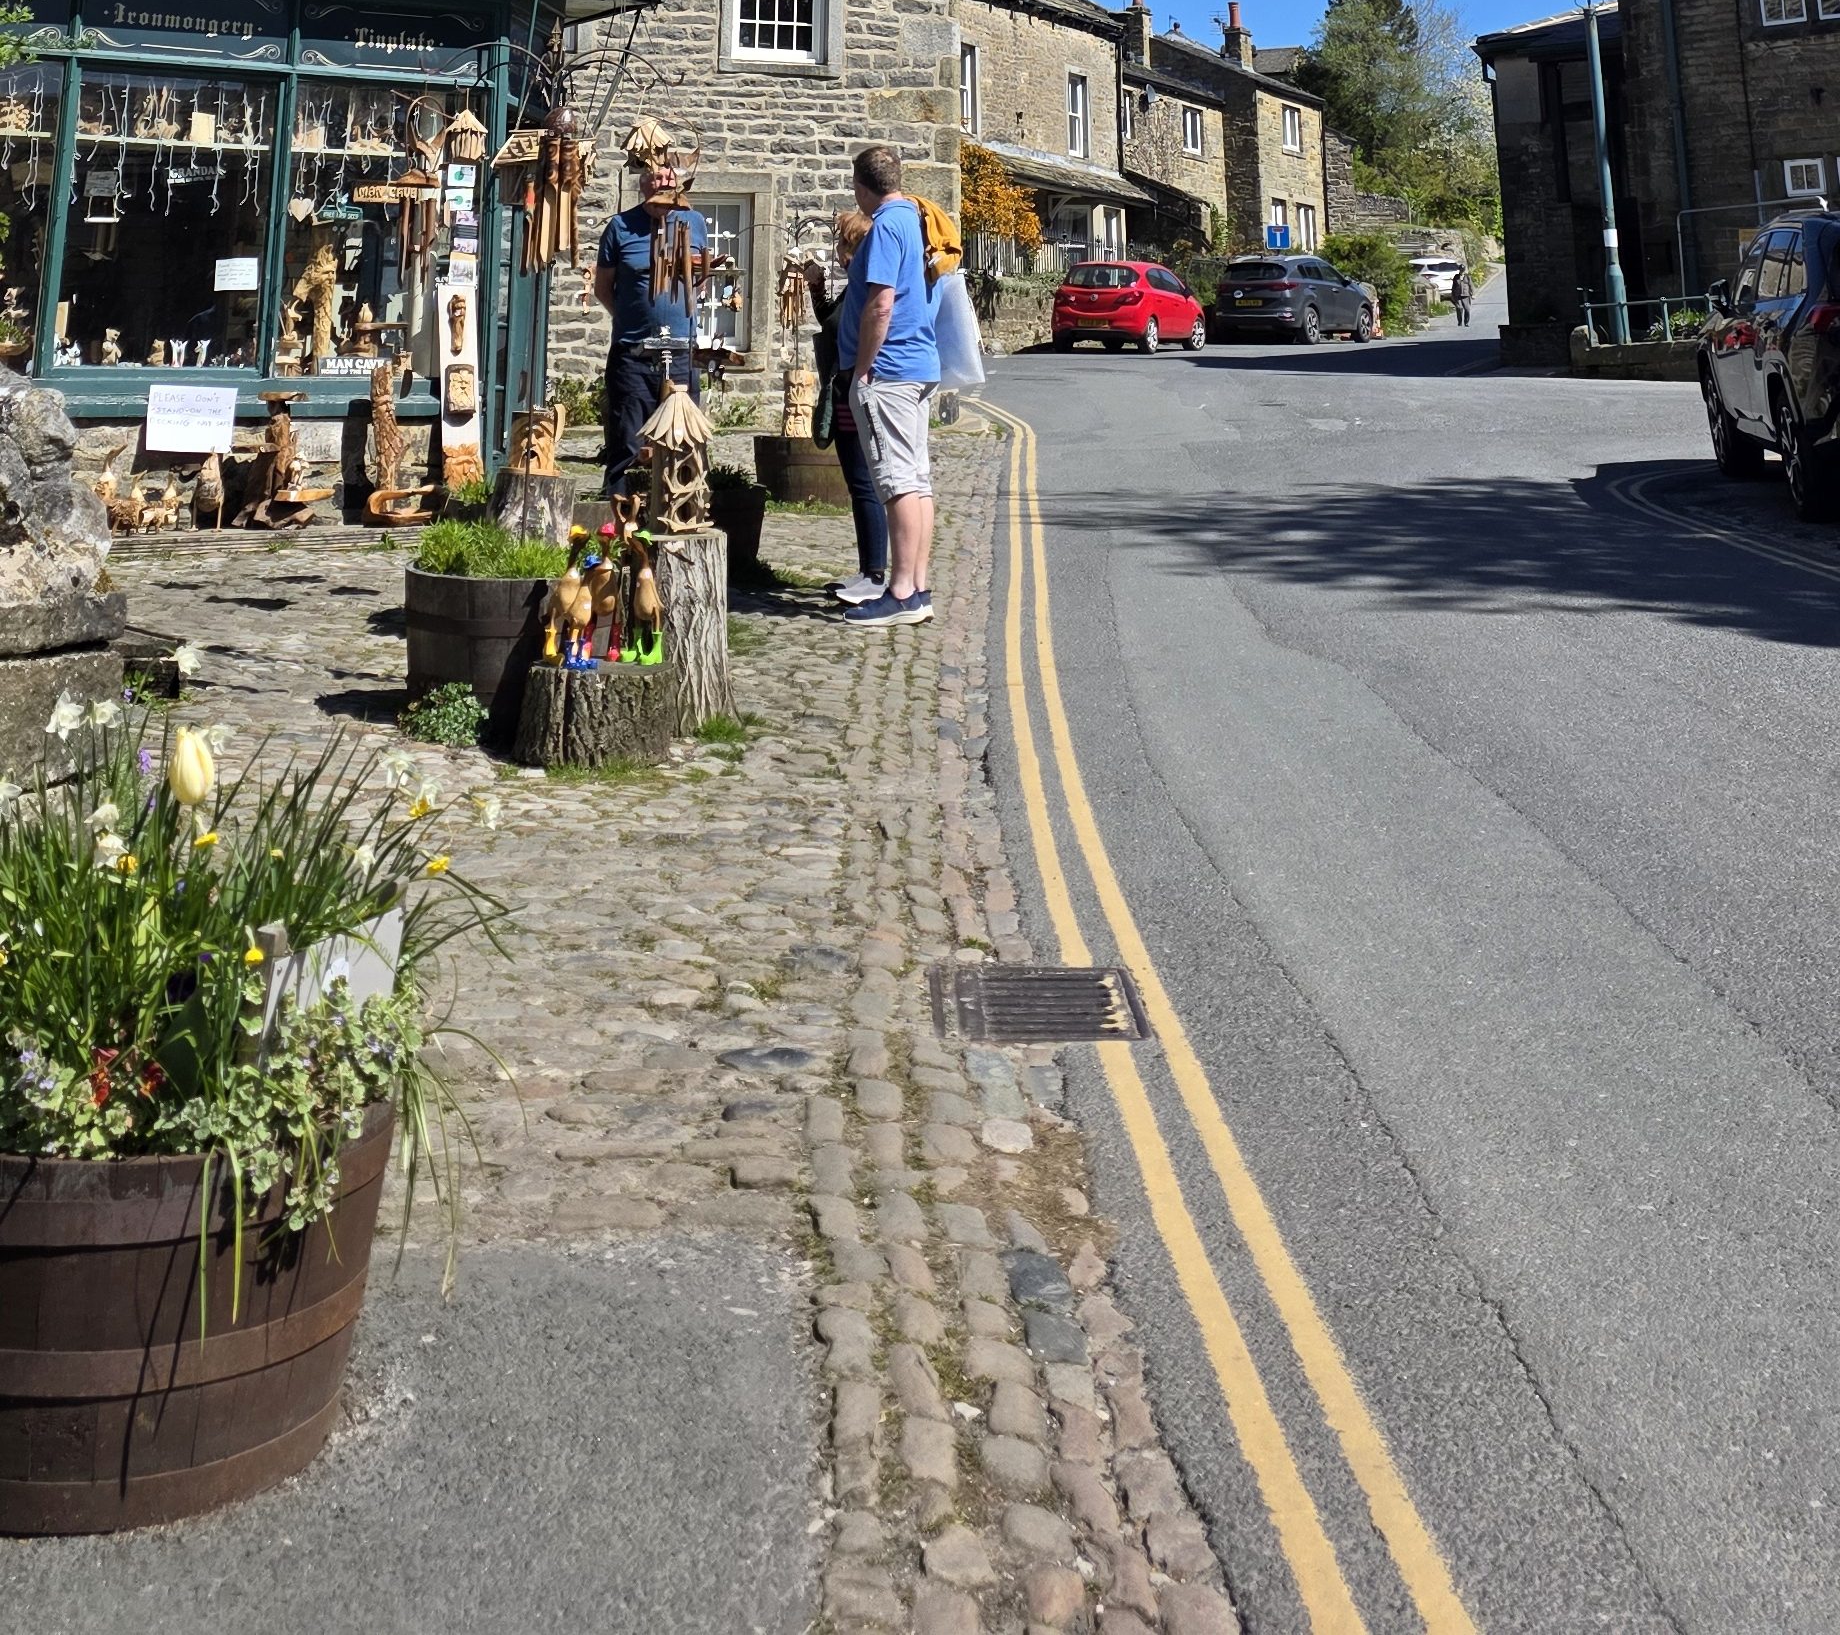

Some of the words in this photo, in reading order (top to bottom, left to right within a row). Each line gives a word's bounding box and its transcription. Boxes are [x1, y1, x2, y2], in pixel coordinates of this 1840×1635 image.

[113, 2, 254, 41] Ironmongery
[354, 27, 434, 54] Tinplate
[326, 358, 353, 369] MAN
[153, 392, 186, 403] PLEASE
